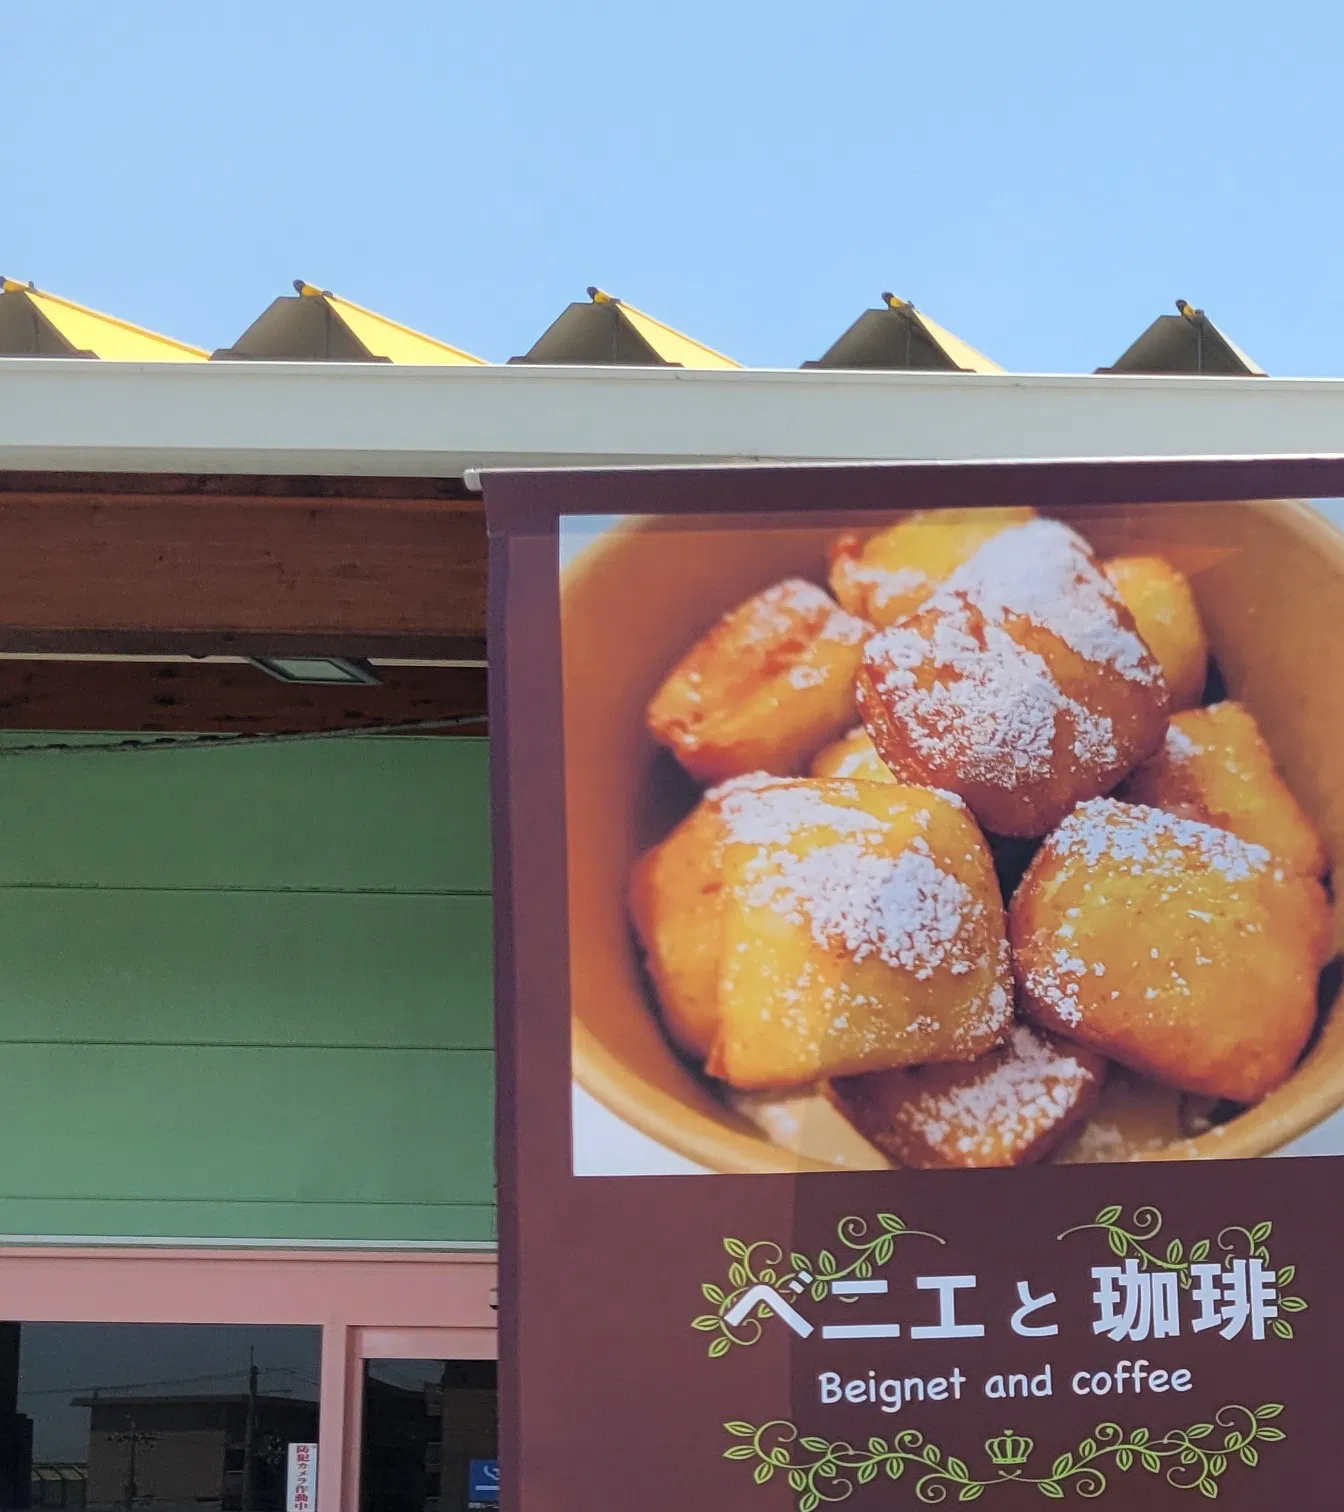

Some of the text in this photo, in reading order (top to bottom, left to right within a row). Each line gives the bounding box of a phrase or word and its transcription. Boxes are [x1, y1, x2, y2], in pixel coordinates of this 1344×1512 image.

[723, 1258, 1279, 1341] ベニエと珈琲
[818, 1360, 1193, 1412] Beignet and coffee
